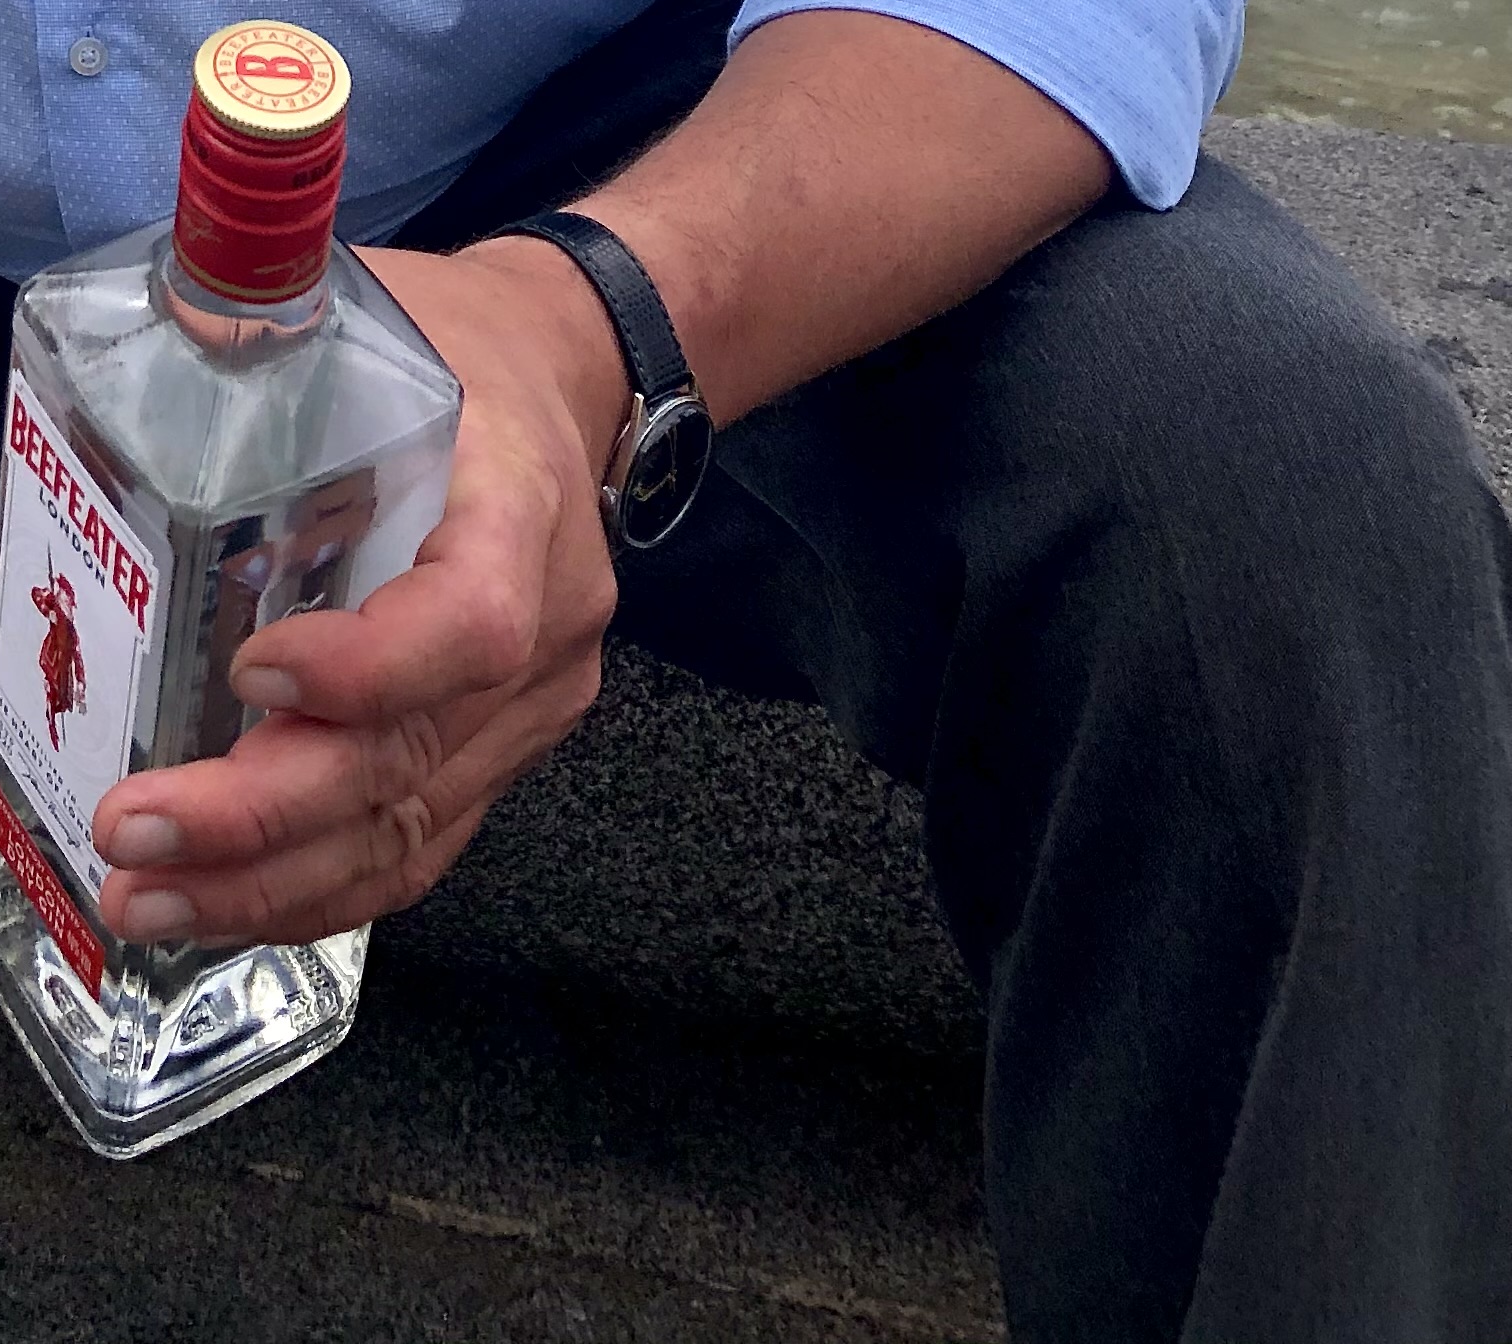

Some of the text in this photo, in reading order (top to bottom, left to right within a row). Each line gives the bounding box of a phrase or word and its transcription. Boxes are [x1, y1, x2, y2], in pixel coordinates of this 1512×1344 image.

[219, 31, 318, 66] BEEFEATER
[230, 71, 330, 109] BEEFEATER
[236, 54, 314, 81] B
[11, 392, 151, 634] BEEFEATER
[39, 486, 106, 590] LONDON
[7, 842, 64, 940] DRY GIN
[8, 830, 65, 926] LONDON
